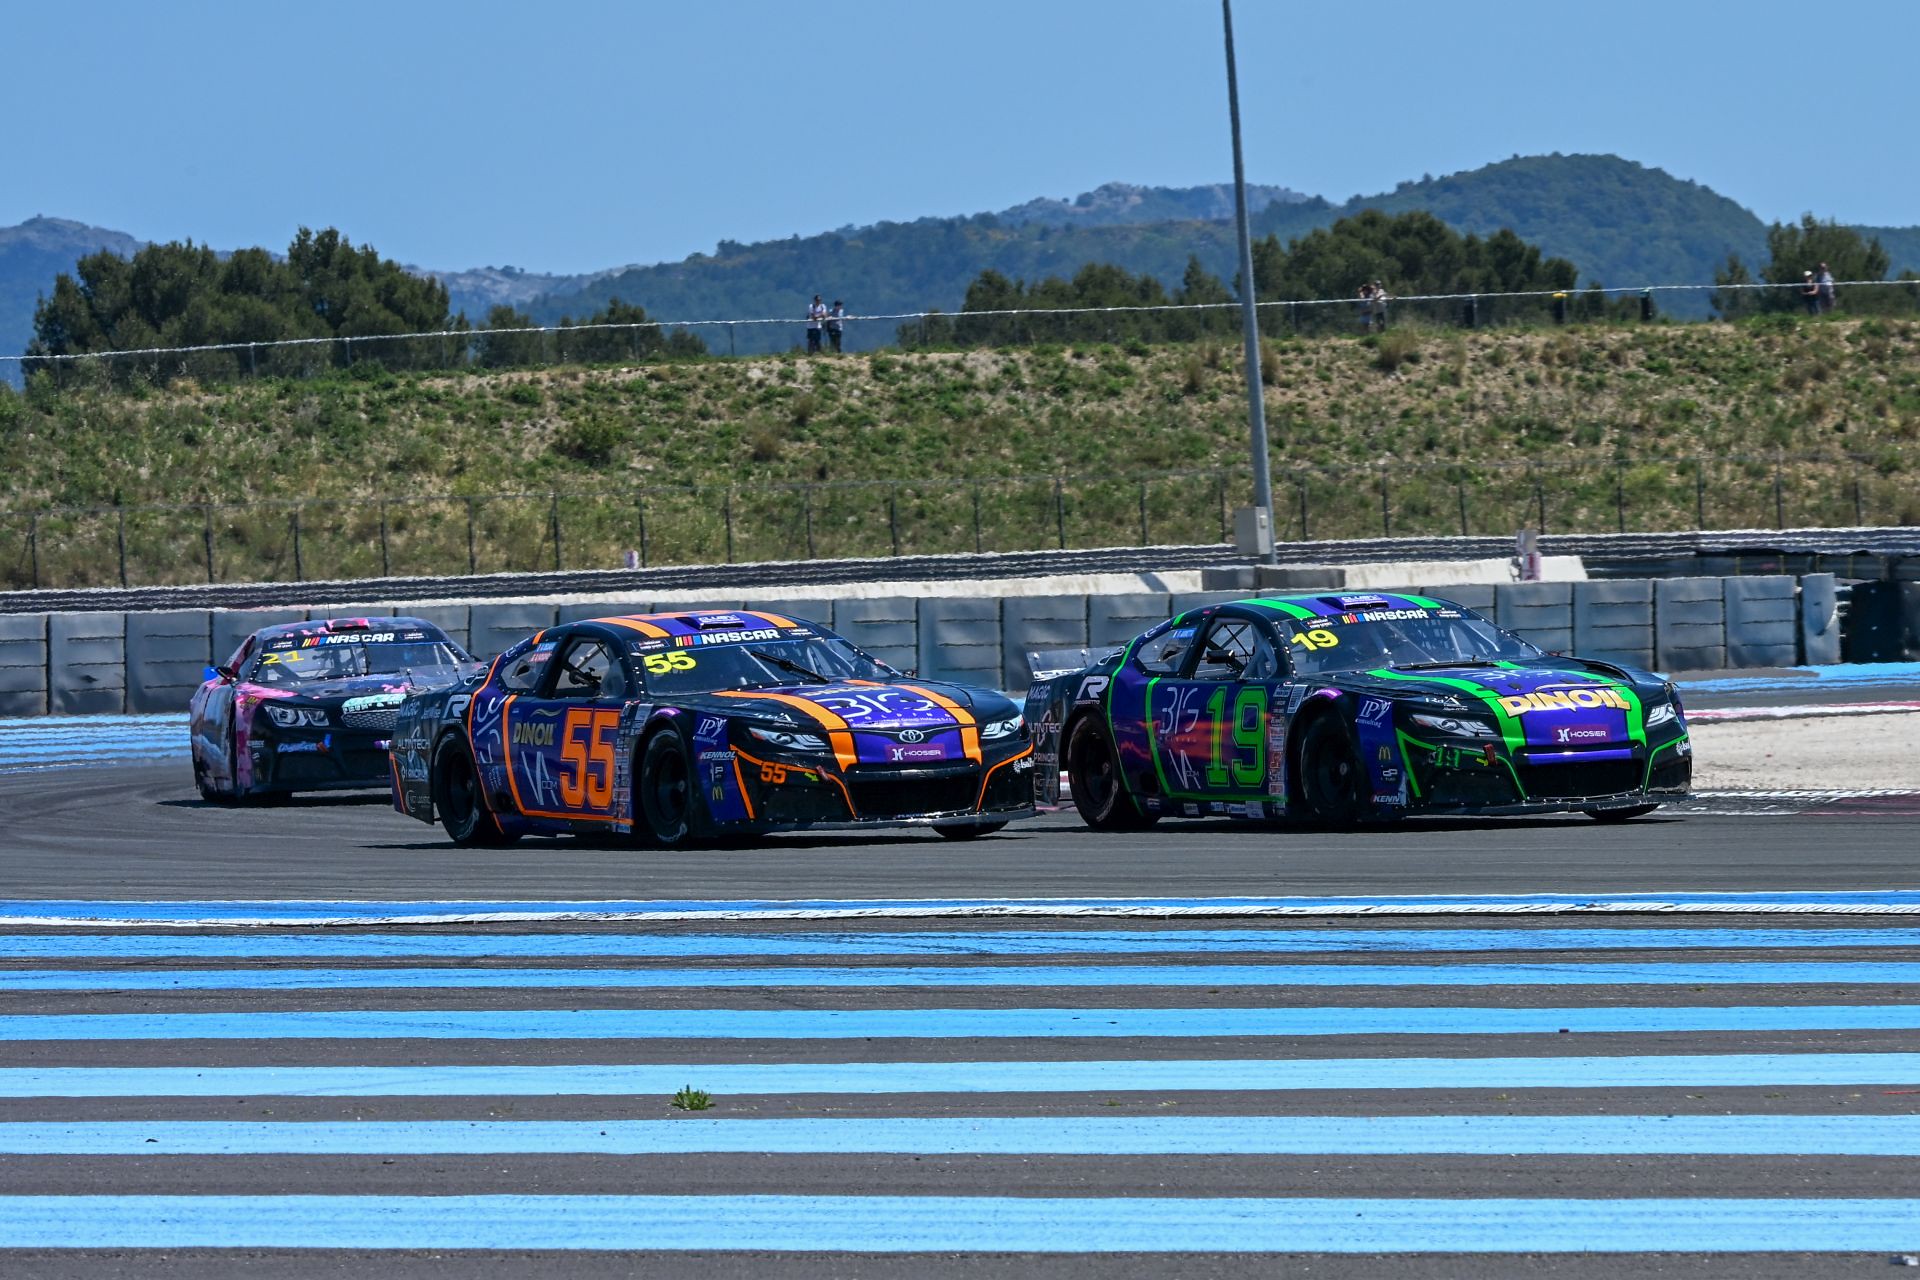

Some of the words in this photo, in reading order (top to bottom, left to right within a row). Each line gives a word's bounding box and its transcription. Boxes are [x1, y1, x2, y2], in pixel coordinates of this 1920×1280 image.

[1365, 609, 1428, 622] NASCAR
[326, 632, 394, 644] NASCAR
[702, 629, 780, 645] NASCAR
[1291, 629, 1338, 651] 19
[262, 651, 304, 665] 21
[643, 651, 696, 673] 55
[1497, 689, 1631, 718] DINOIL
[513, 721, 556, 746] DINOIL
[1205, 686, 1268, 787] 19
[1570, 730, 1607, 738] HOOSIER
[560, 707, 622, 810] 55
[699, 751, 736, 760] KENNOL
[904, 749, 941, 757] HOOSIER
[761, 762, 787, 784] 55
